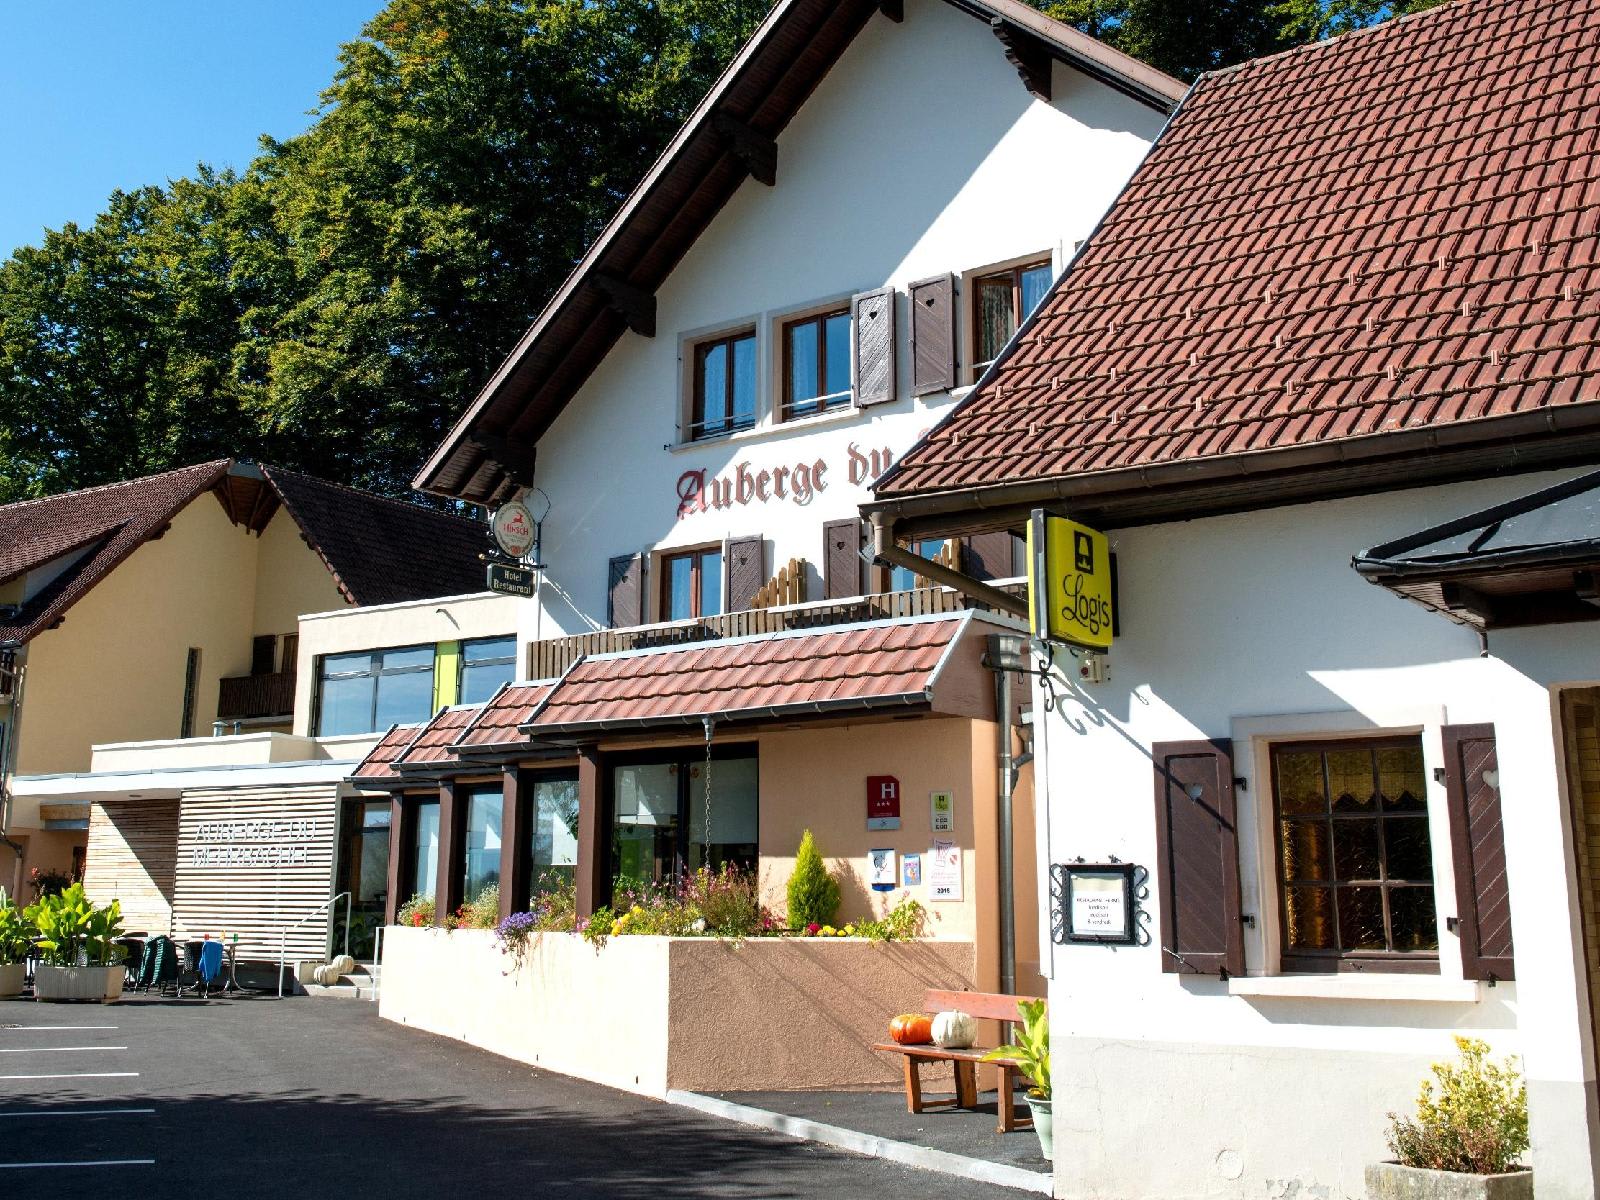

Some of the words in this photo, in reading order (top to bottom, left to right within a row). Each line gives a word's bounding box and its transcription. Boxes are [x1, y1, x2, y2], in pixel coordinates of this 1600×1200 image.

[676, 458, 828, 520] Auberge
[847, 442, 893, 486] du
[493, 578, 531, 594] Restaurant
[1062, 574, 1110, 636] Logis
[881, 783, 896, 799] H
[195, 820, 284, 842] AUBERGE
[290, 817, 317, 841] DU
